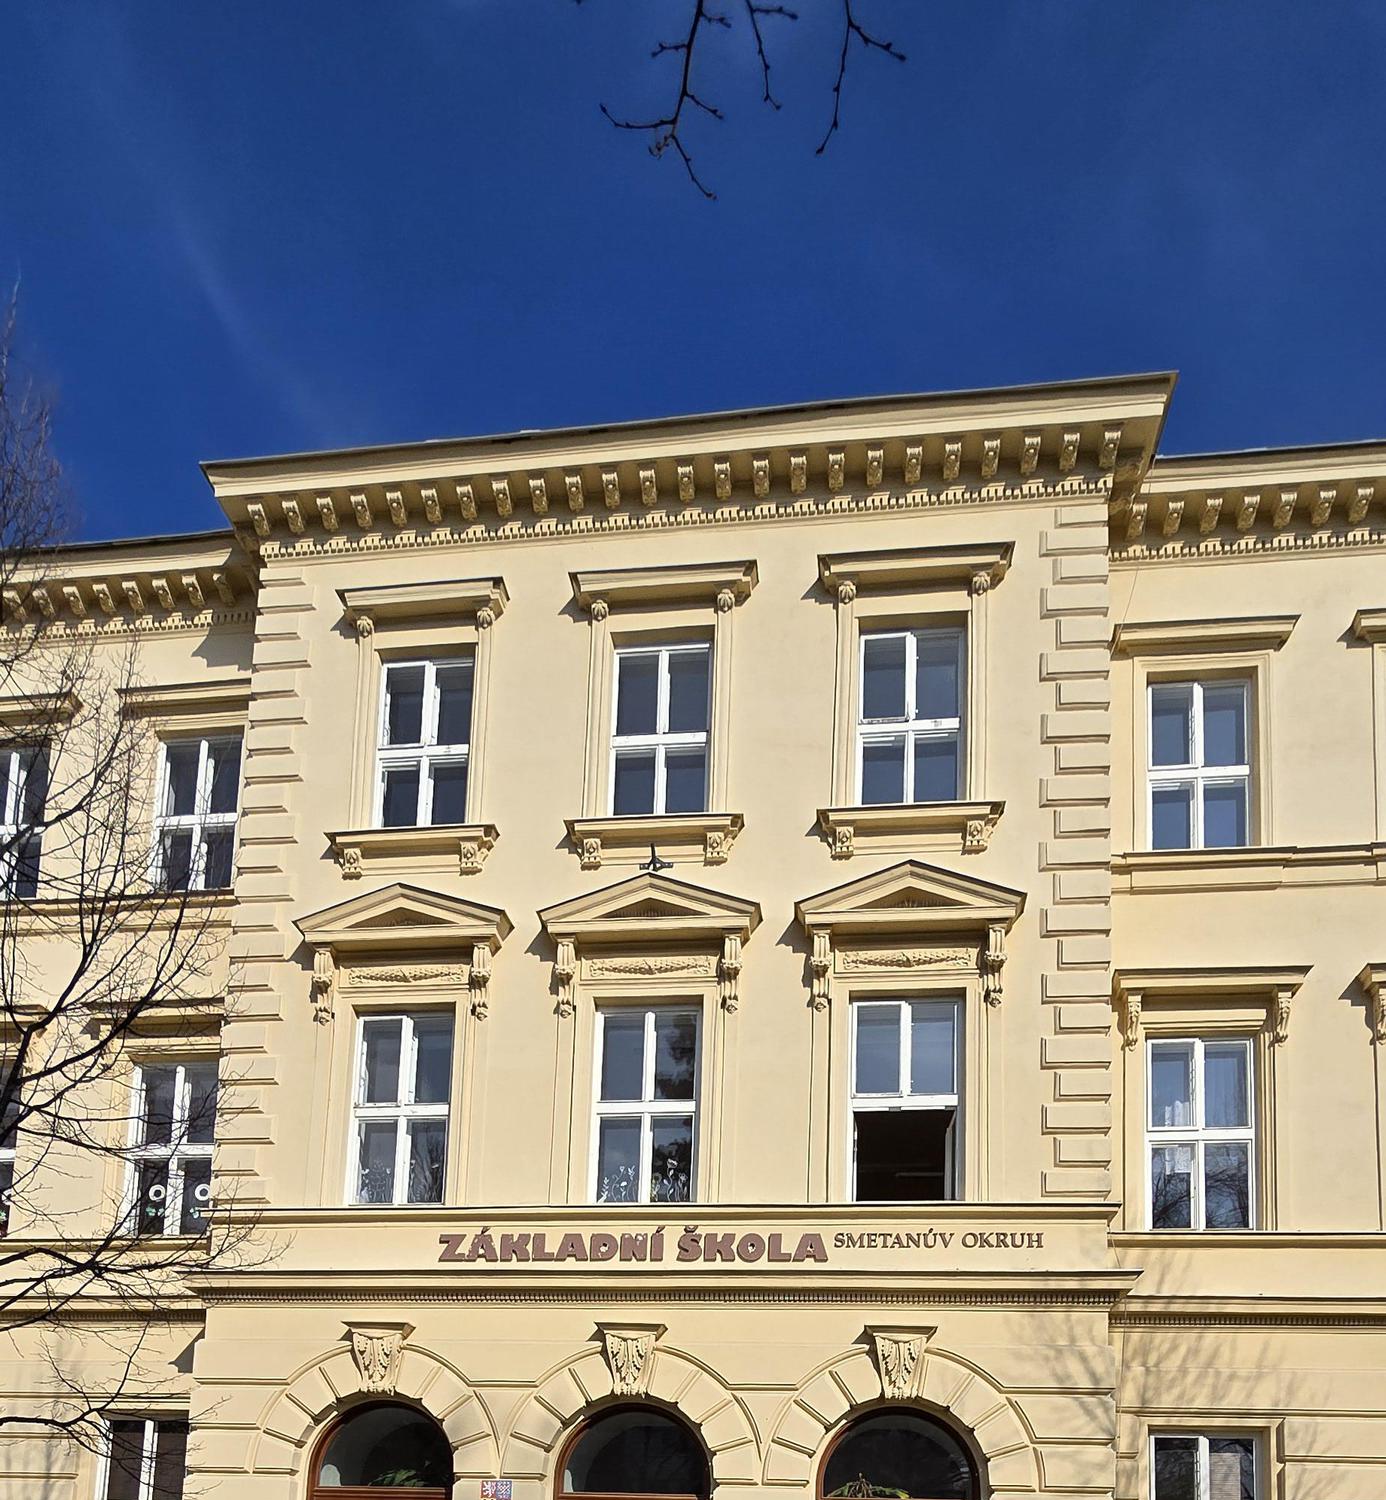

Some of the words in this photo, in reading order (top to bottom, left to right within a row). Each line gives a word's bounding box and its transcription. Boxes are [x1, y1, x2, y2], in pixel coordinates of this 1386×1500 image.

[438, 1225, 666, 1263] ZÁKLADNÍ
[676, 1225, 829, 1263] ŠKOLA
[961, 1232, 1045, 1249] OKRUH
